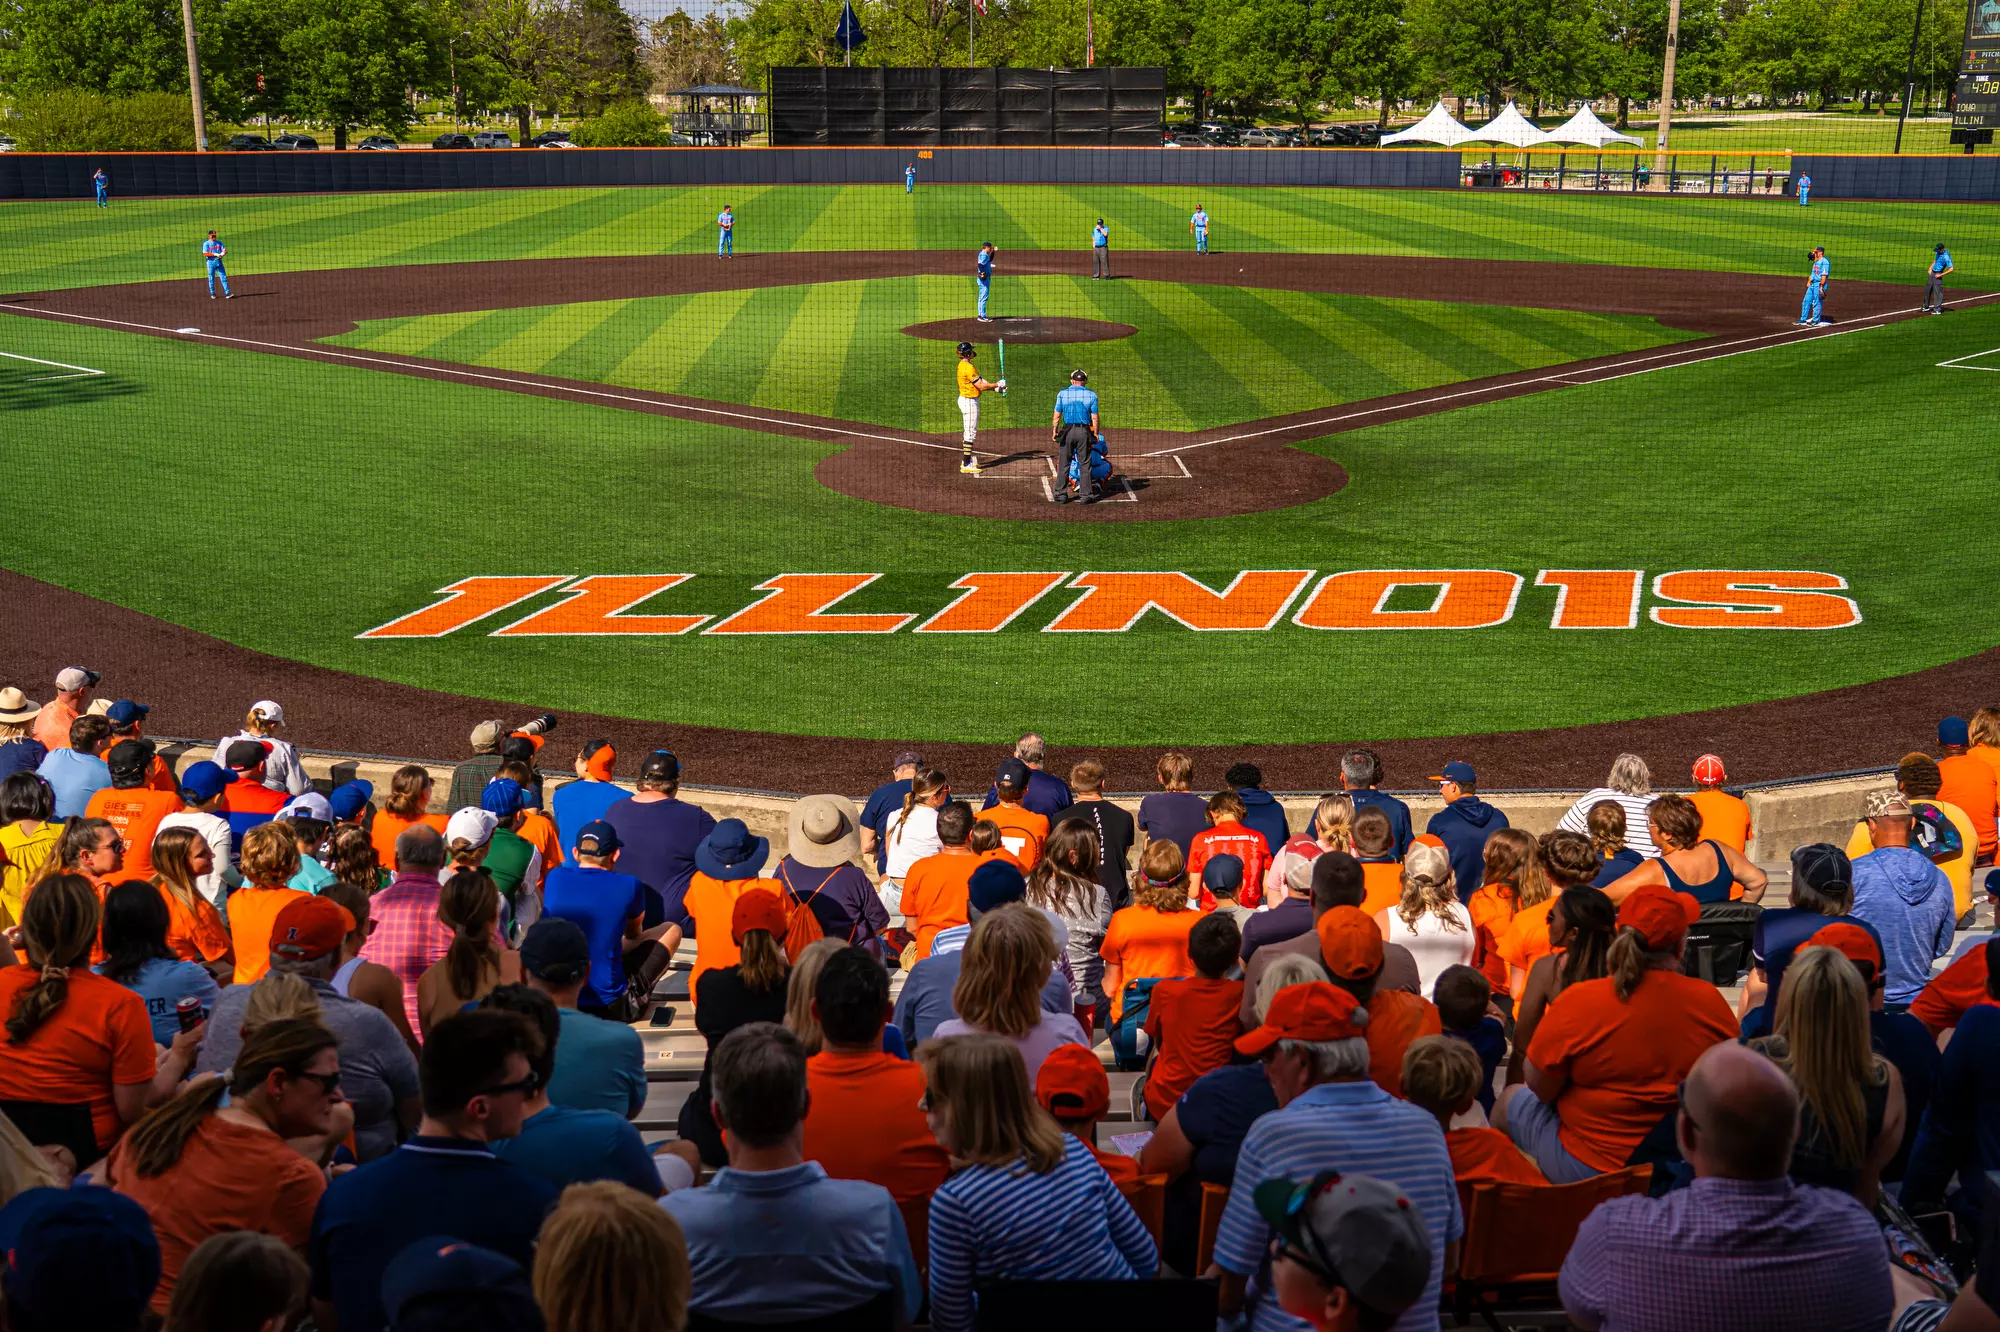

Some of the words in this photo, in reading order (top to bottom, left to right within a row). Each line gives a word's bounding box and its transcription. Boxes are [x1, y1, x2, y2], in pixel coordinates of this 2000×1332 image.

[1972, 82, 2000, 94] 4:08
[1956, 103, 1977, 112] IOWA
[1954, 115, 1984, 124] ILLINI
[917, 150, 933, 159] 400
[353, 567, 1864, 639] ILLINOIS
[104, 802, 127, 810] GIES
[102, 809, 141, 817] BUSINESS
